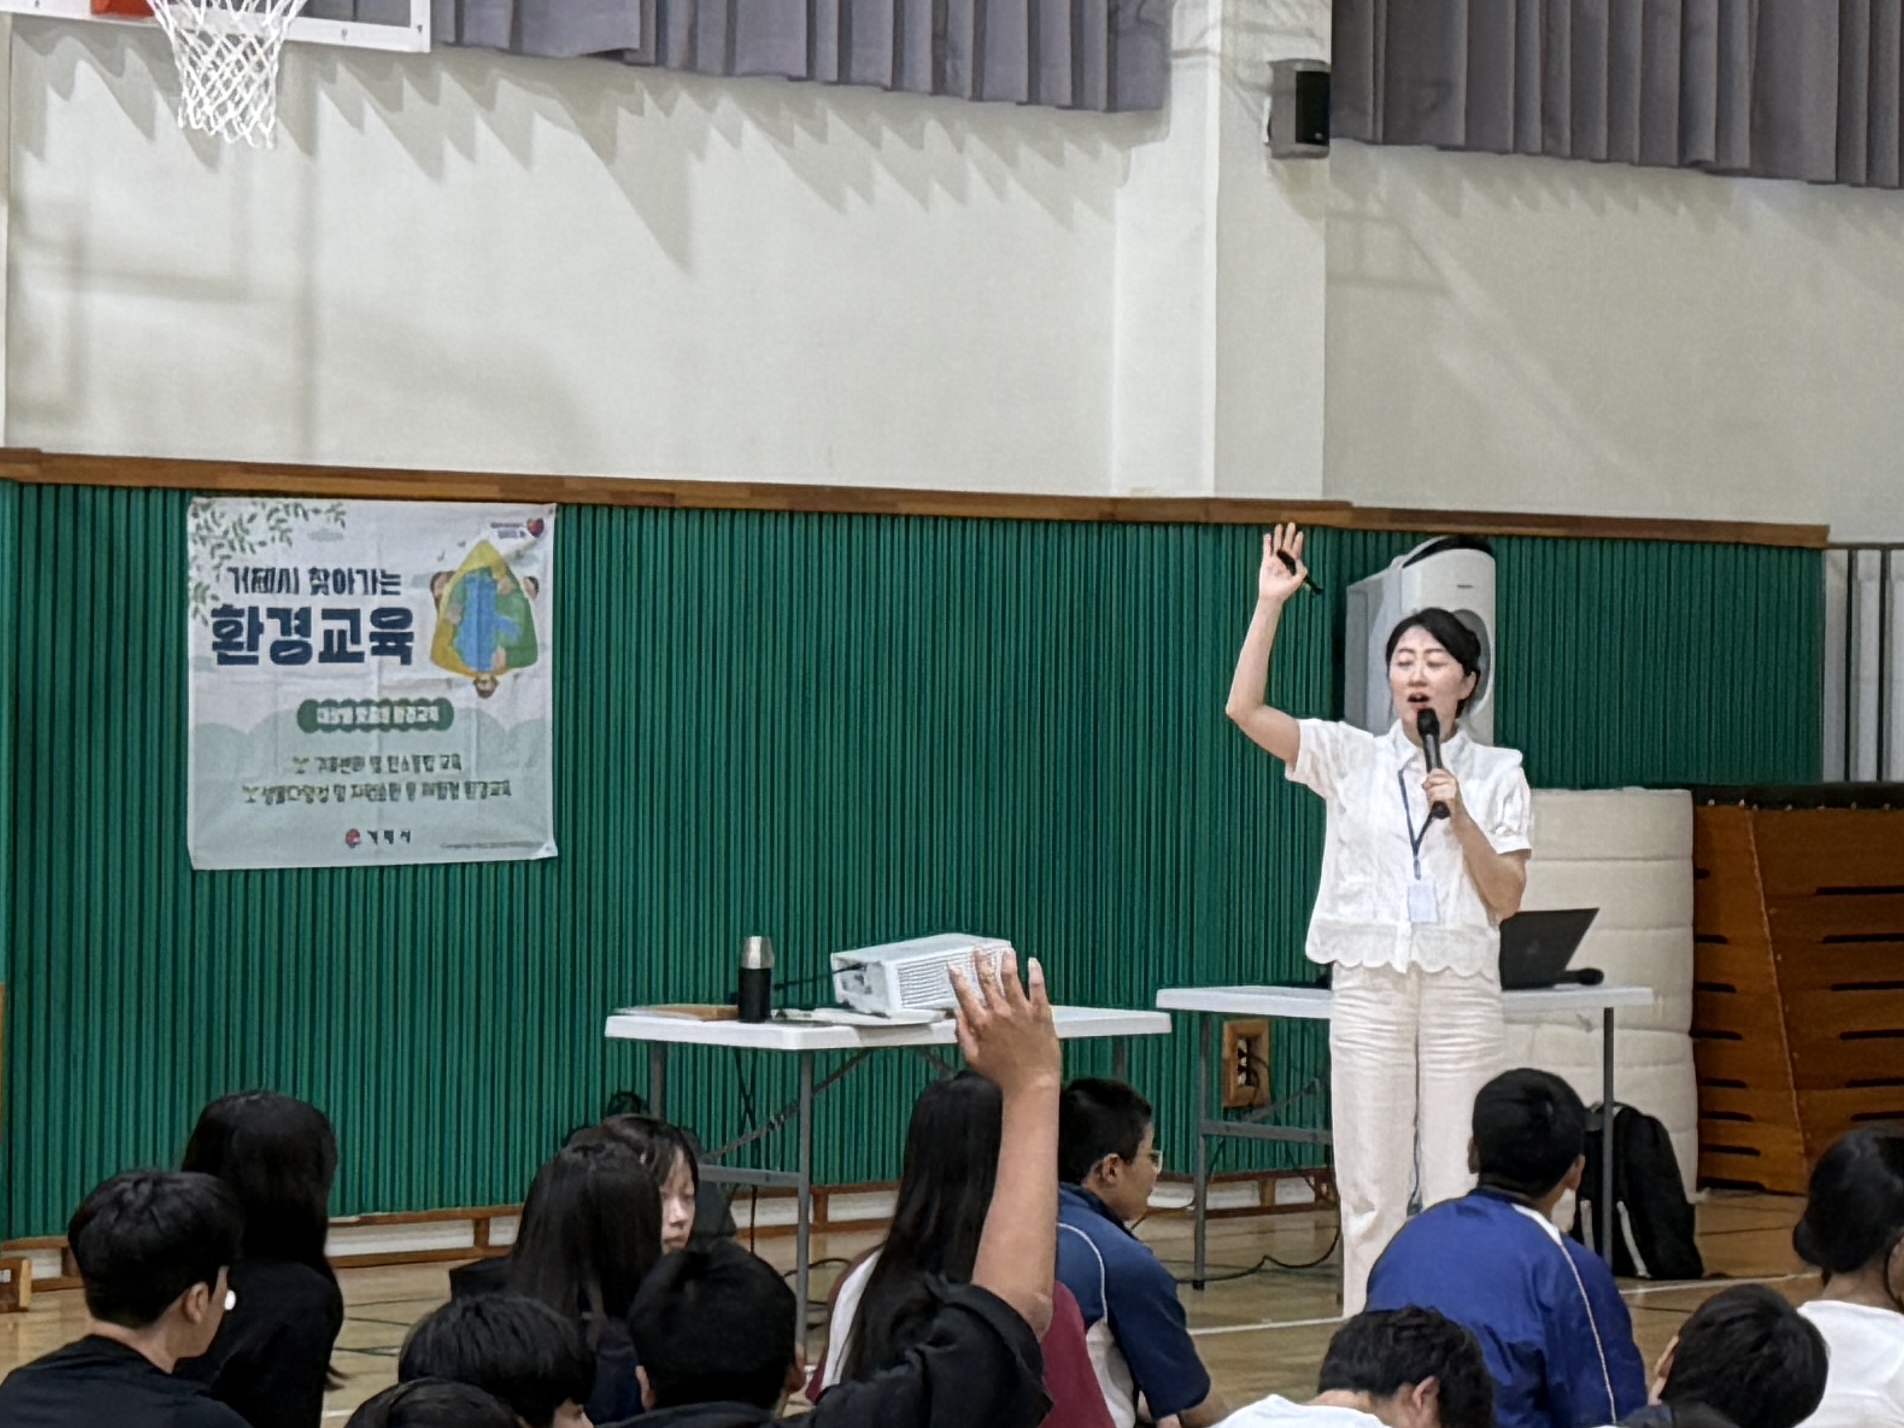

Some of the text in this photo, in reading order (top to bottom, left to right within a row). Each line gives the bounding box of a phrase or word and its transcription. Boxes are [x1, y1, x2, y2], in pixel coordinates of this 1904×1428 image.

[226, 566, 402, 595] 거제시 찾아가는
[210, 603, 415, 666] 환경교육
